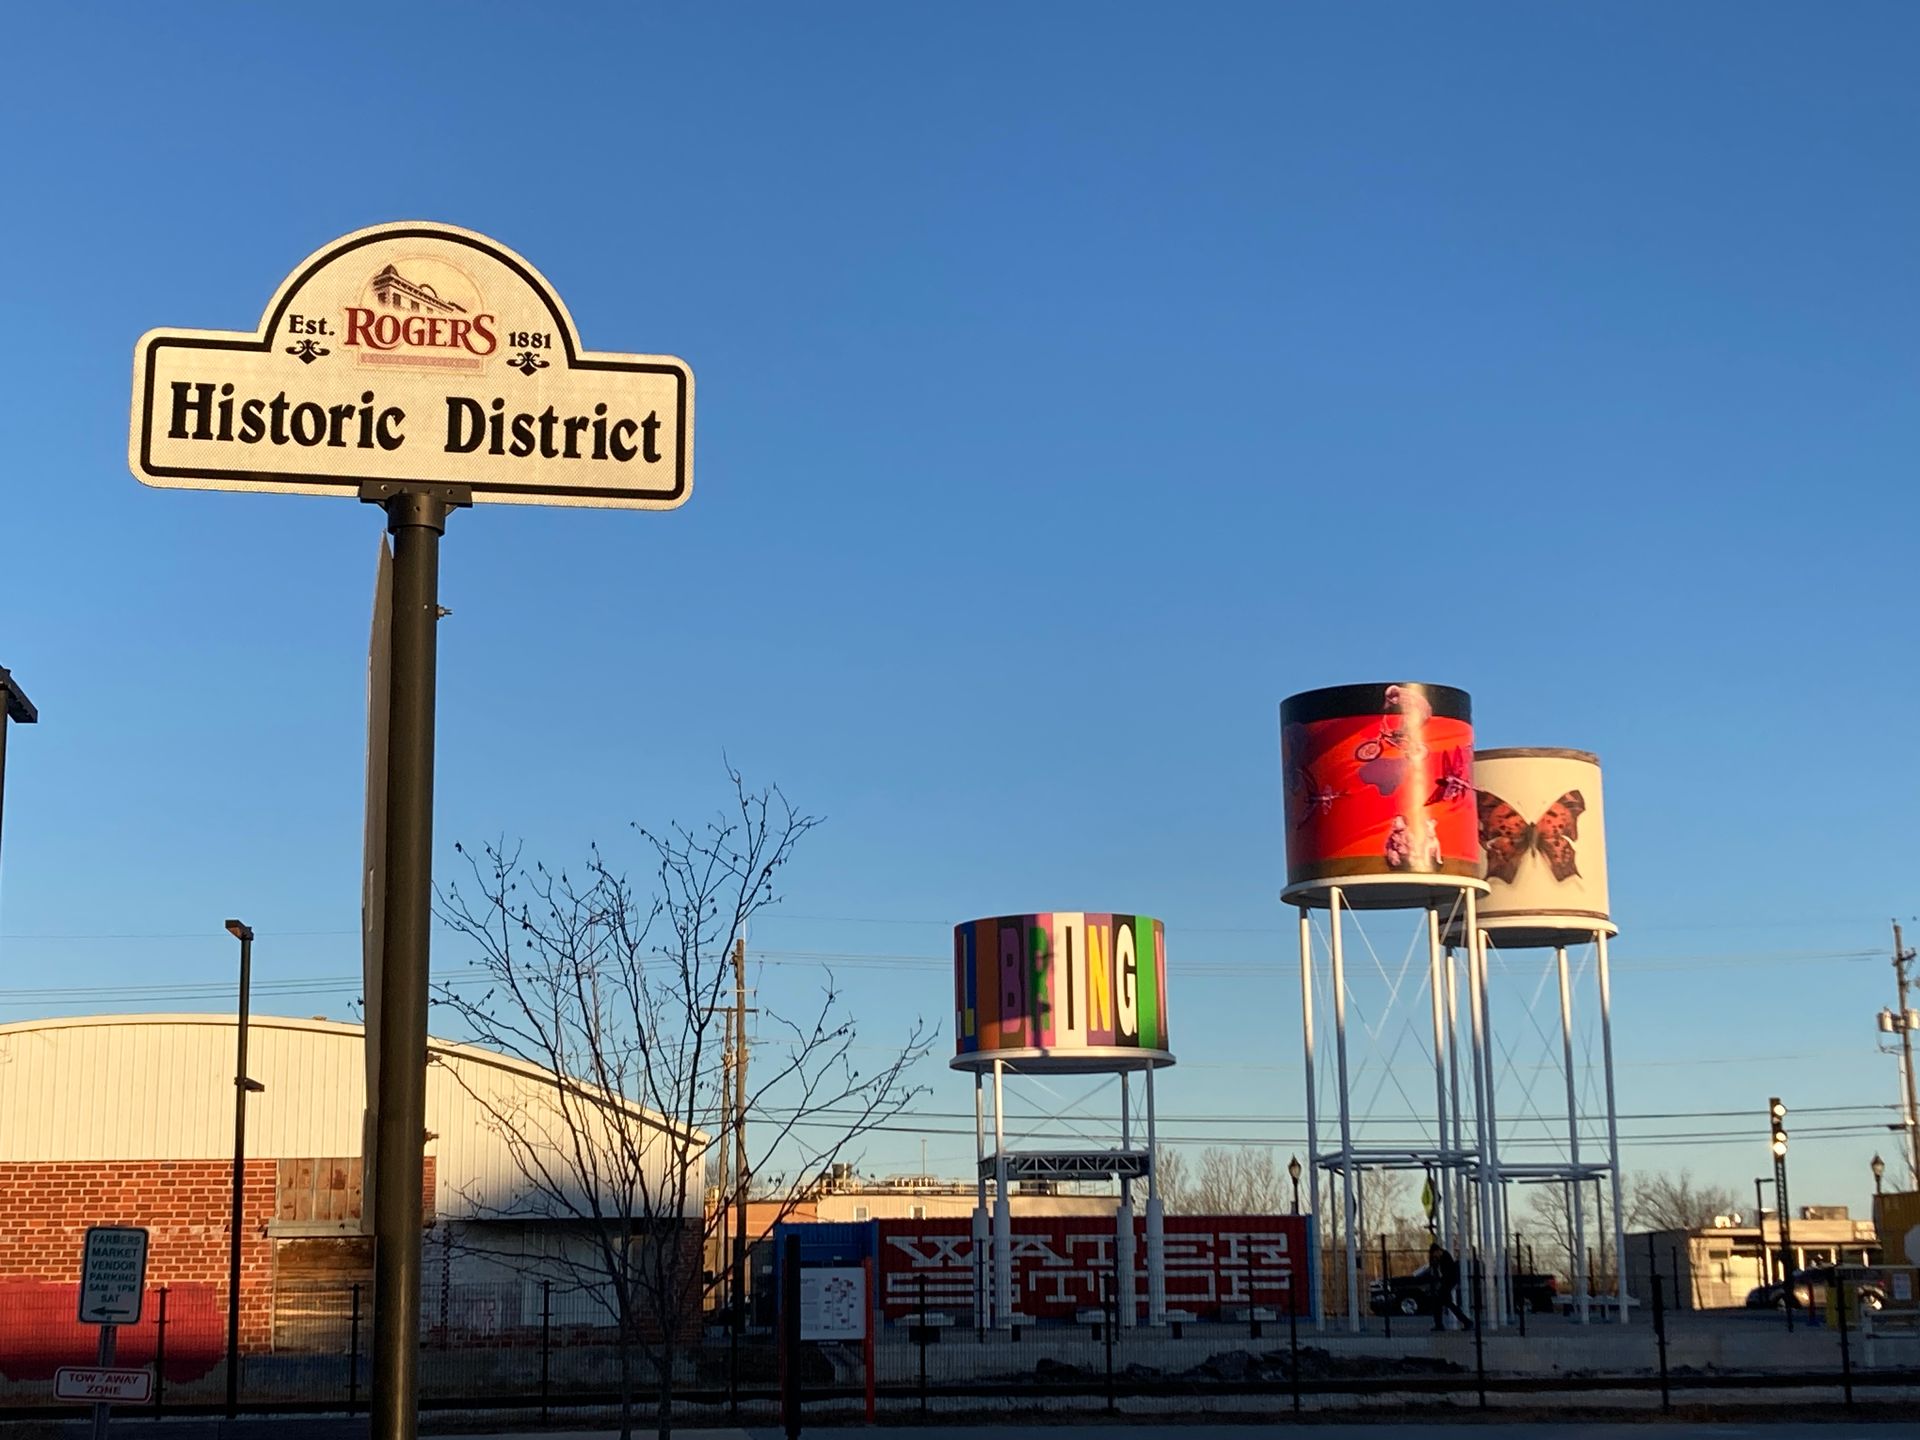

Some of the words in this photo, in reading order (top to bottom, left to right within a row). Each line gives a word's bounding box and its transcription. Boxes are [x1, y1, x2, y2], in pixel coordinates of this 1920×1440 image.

[288, 314, 335, 336] Est.
[344, 307, 497, 356] ROGERS
[509, 331, 552, 350] 1881
[168, 381, 406, 451] Historic
[444, 396, 662, 464] District
[92, 1248, 138, 1258] MARKET
[886, 1232, 1292, 1267] WATER
[91, 1260, 136, 1271] VENDOR
[89, 1272, 136, 1282] PARKING
[101, 1294, 121, 1303] SAT
[69, 1373, 97, 1383] TOW
[105, 1374, 139, 1384] AWAY
[86, 1385, 121, 1395] ZONE
